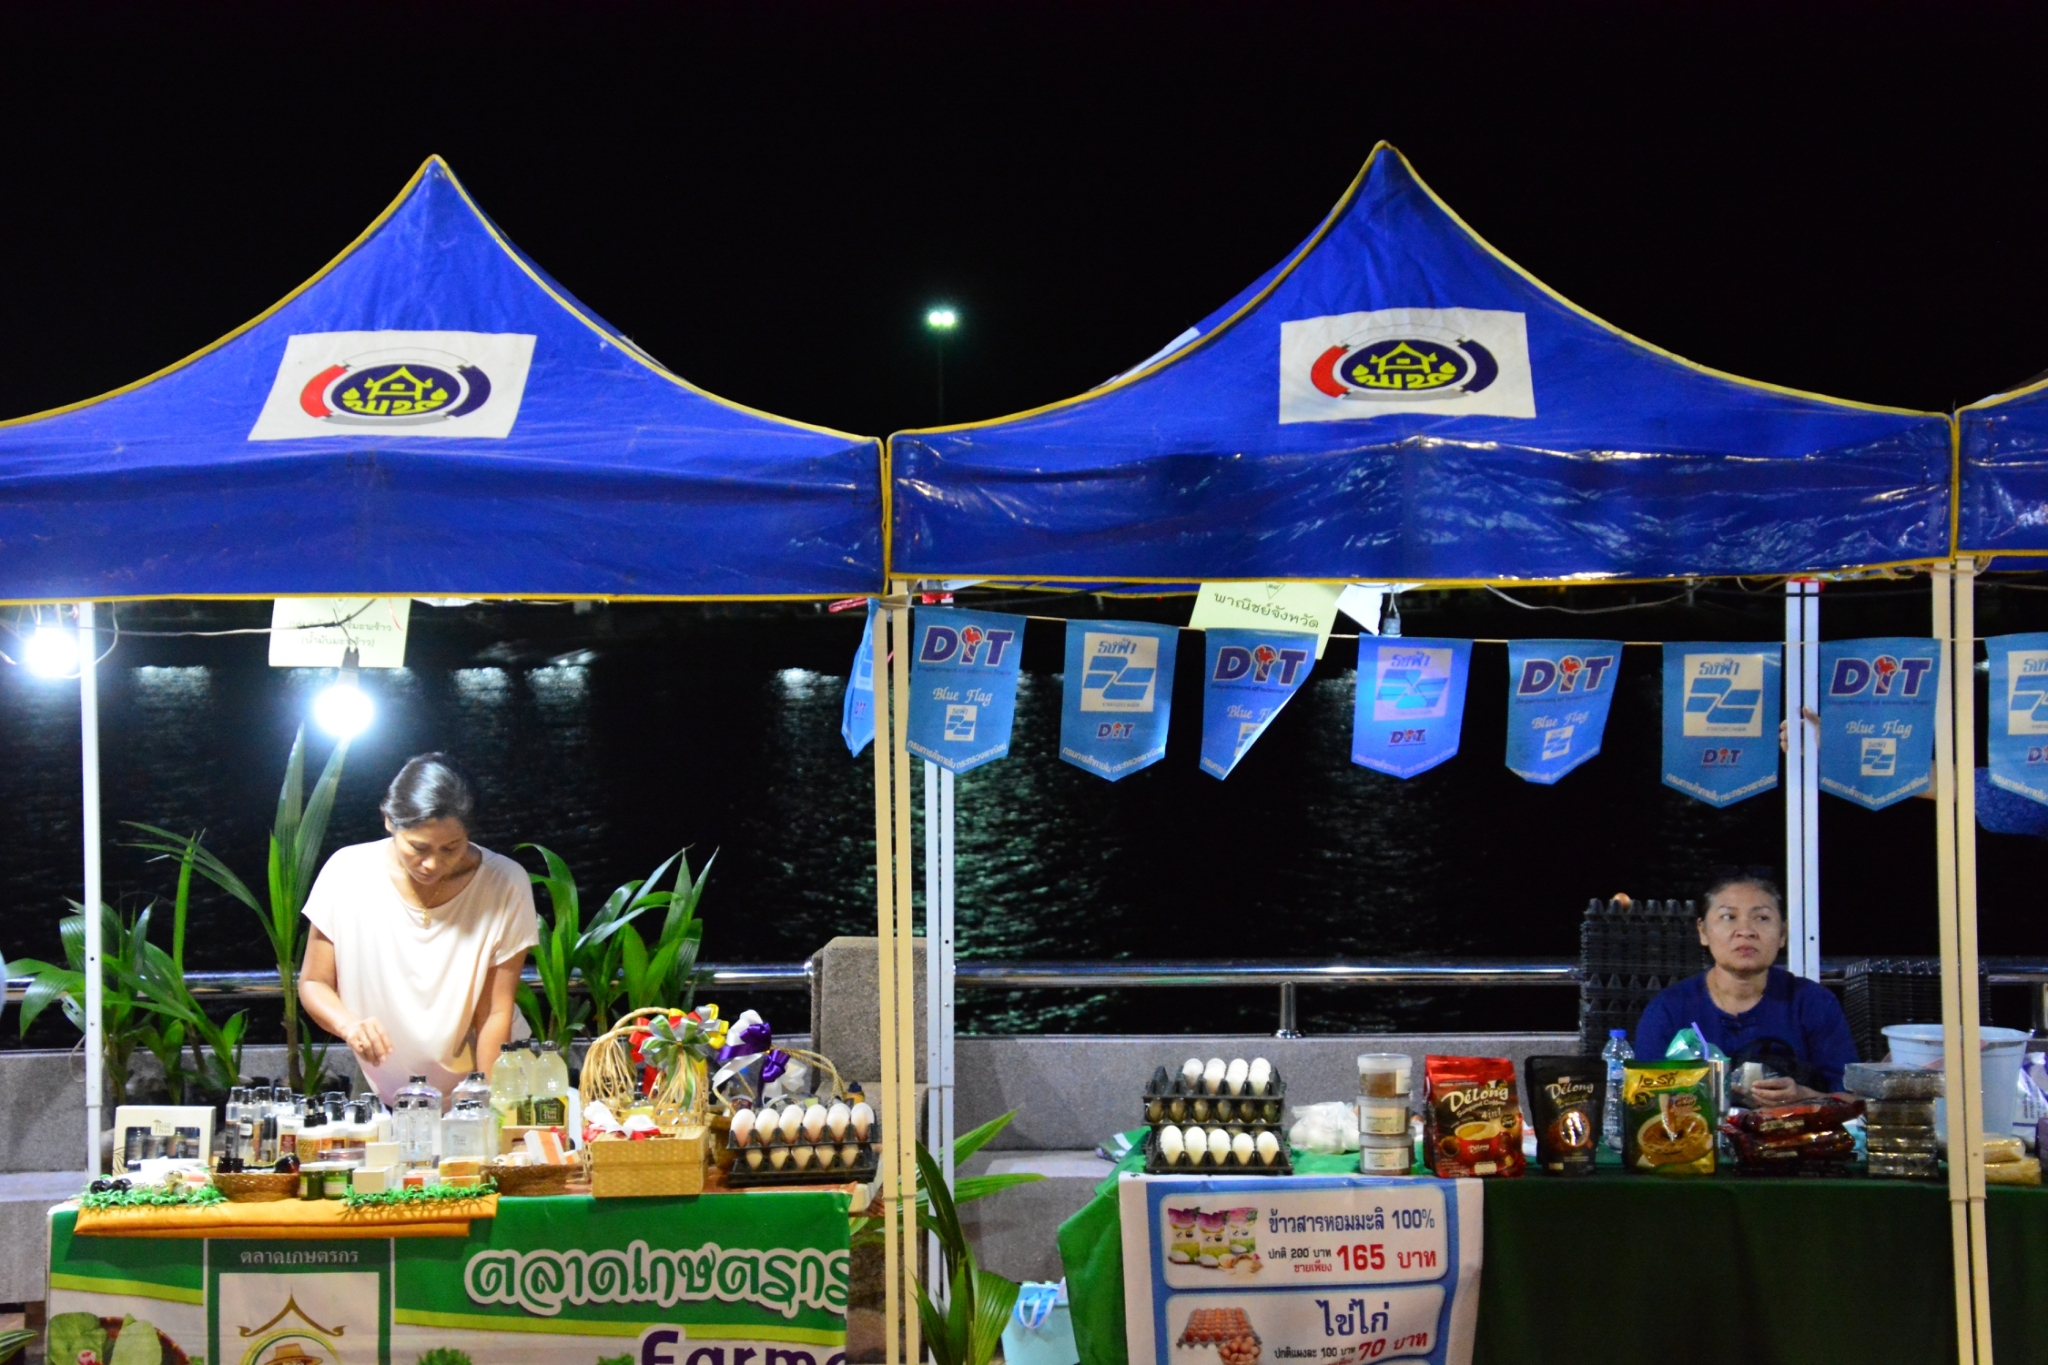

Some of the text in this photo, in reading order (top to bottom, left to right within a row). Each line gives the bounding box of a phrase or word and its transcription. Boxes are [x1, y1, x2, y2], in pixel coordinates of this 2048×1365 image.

[1214, 592, 1319, 629] พาณิชย์จังหวัด
[919, 625, 1015, 666] DIT
[1097, 637, 1137, 655] ธงฟ้า
[1213, 644, 1308, 686] DIT
[1391, 650, 1431, 667] ธงฟ้า
[1699, 657, 1740, 676] ธงฟ้า
[1517, 655, 1614, 695] DIT
[1829, 654, 1933, 697] DIT
[933, 686, 993, 707] Blue Flag
[1227, 704, 1253, 719] Blue
[1531, 710, 1590, 730] Blue Flag
[1096, 722, 1134, 739] DIT
[1389, 728, 1426, 743] DIT
[1845, 719, 1913, 739] Blue Flag
[1702, 748, 1743, 764] DIT
[1441, 1088, 1509, 1112] Délong
[1545, 1083, 1594, 1099] Délong
[1269, 1206, 1435, 1233] ข้าวสารหอมมะลิ 100%
[240, 1250, 359, 1264] ตลาดเกษตรกร
[1268, 1246, 1332, 1259] ปกติ 200 บาท
[1336, 1243, 1437, 1271] 165 บาท
[1294, 1259, 1333, 1273] ขายเพียง
[1315, 1298, 1389, 1336] ไข่ไก่
[1320, 1347, 1338, 1357] 100
[1340, 1346, 1356, 1356] บาท
[1358, 1332, 1429, 1361] 70 บาท
